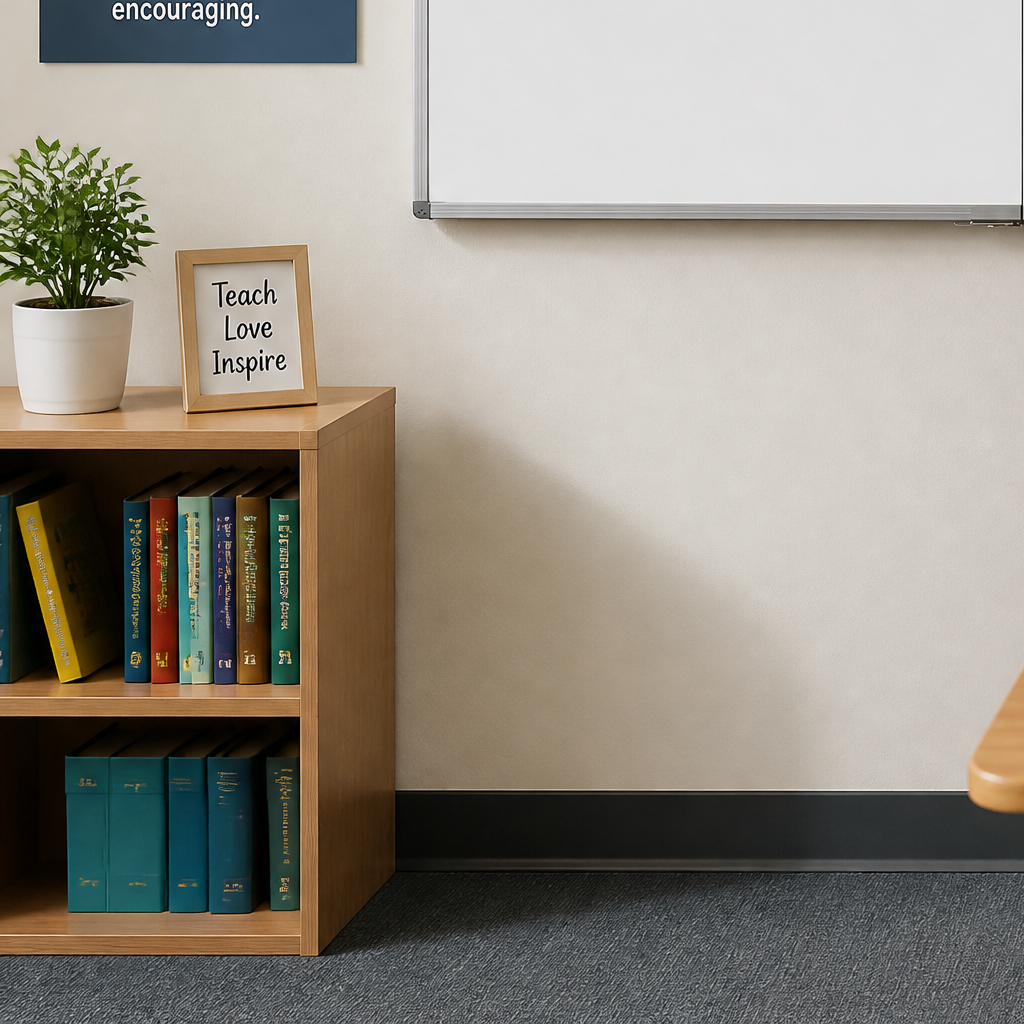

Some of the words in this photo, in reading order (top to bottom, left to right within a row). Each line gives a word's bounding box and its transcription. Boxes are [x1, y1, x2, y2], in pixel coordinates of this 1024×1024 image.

[211, 278, 278, 308] Teach
[225, 314, 273, 342] Love
[212, 348, 287, 382] Inspire
